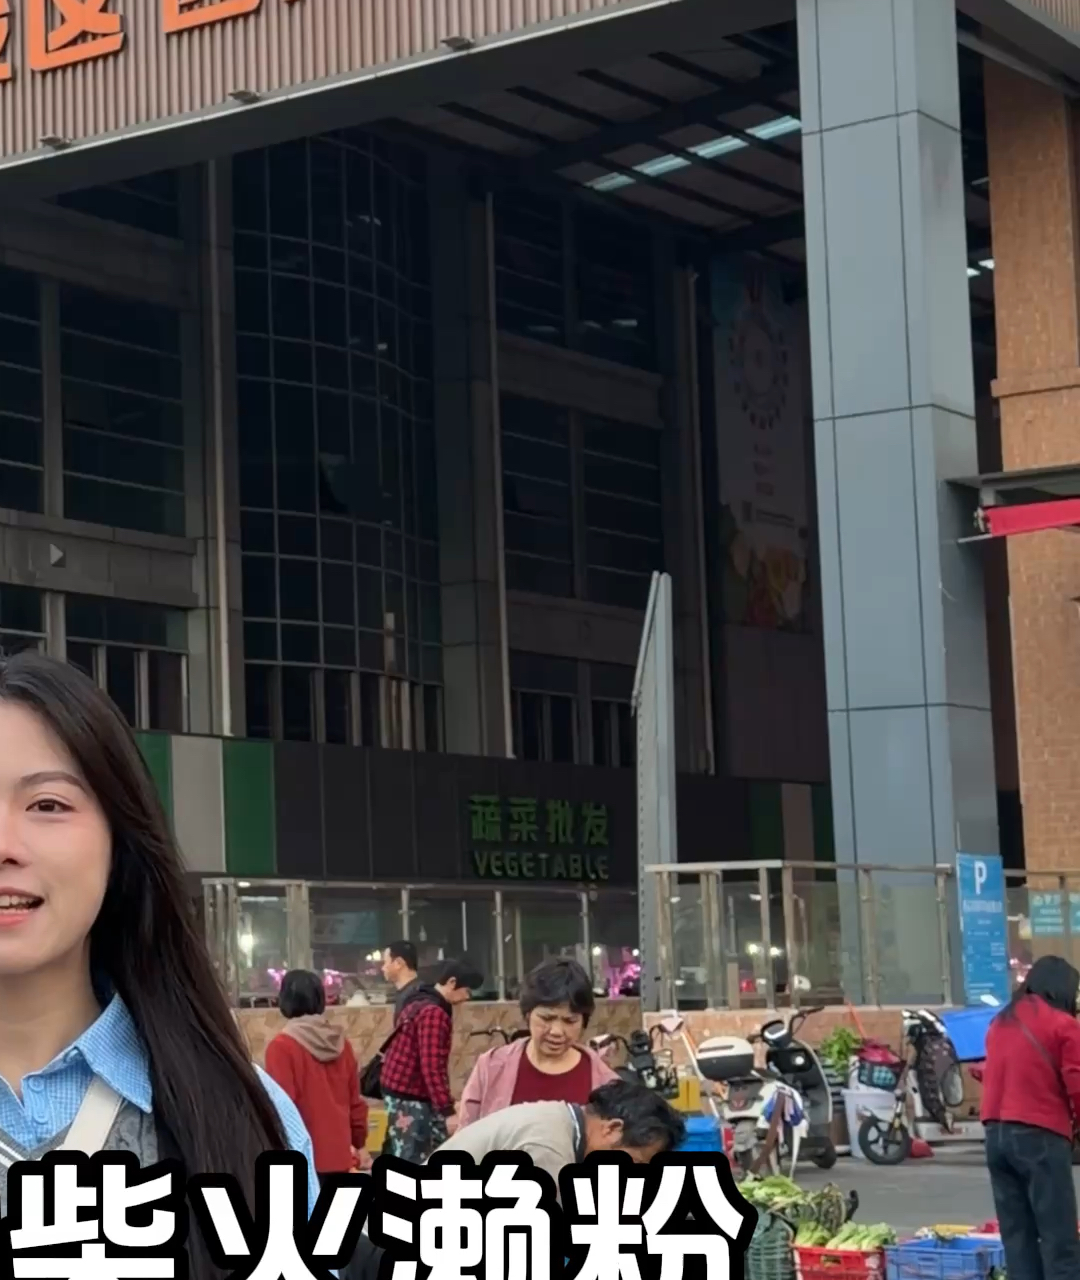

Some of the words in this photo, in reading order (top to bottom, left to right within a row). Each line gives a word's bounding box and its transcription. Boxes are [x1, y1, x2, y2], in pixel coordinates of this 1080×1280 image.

[469, 794, 609, 845] 蔬菜批发
[473, 850, 610, 880] VEGETABLE
[973, 860, 988, 896] P
